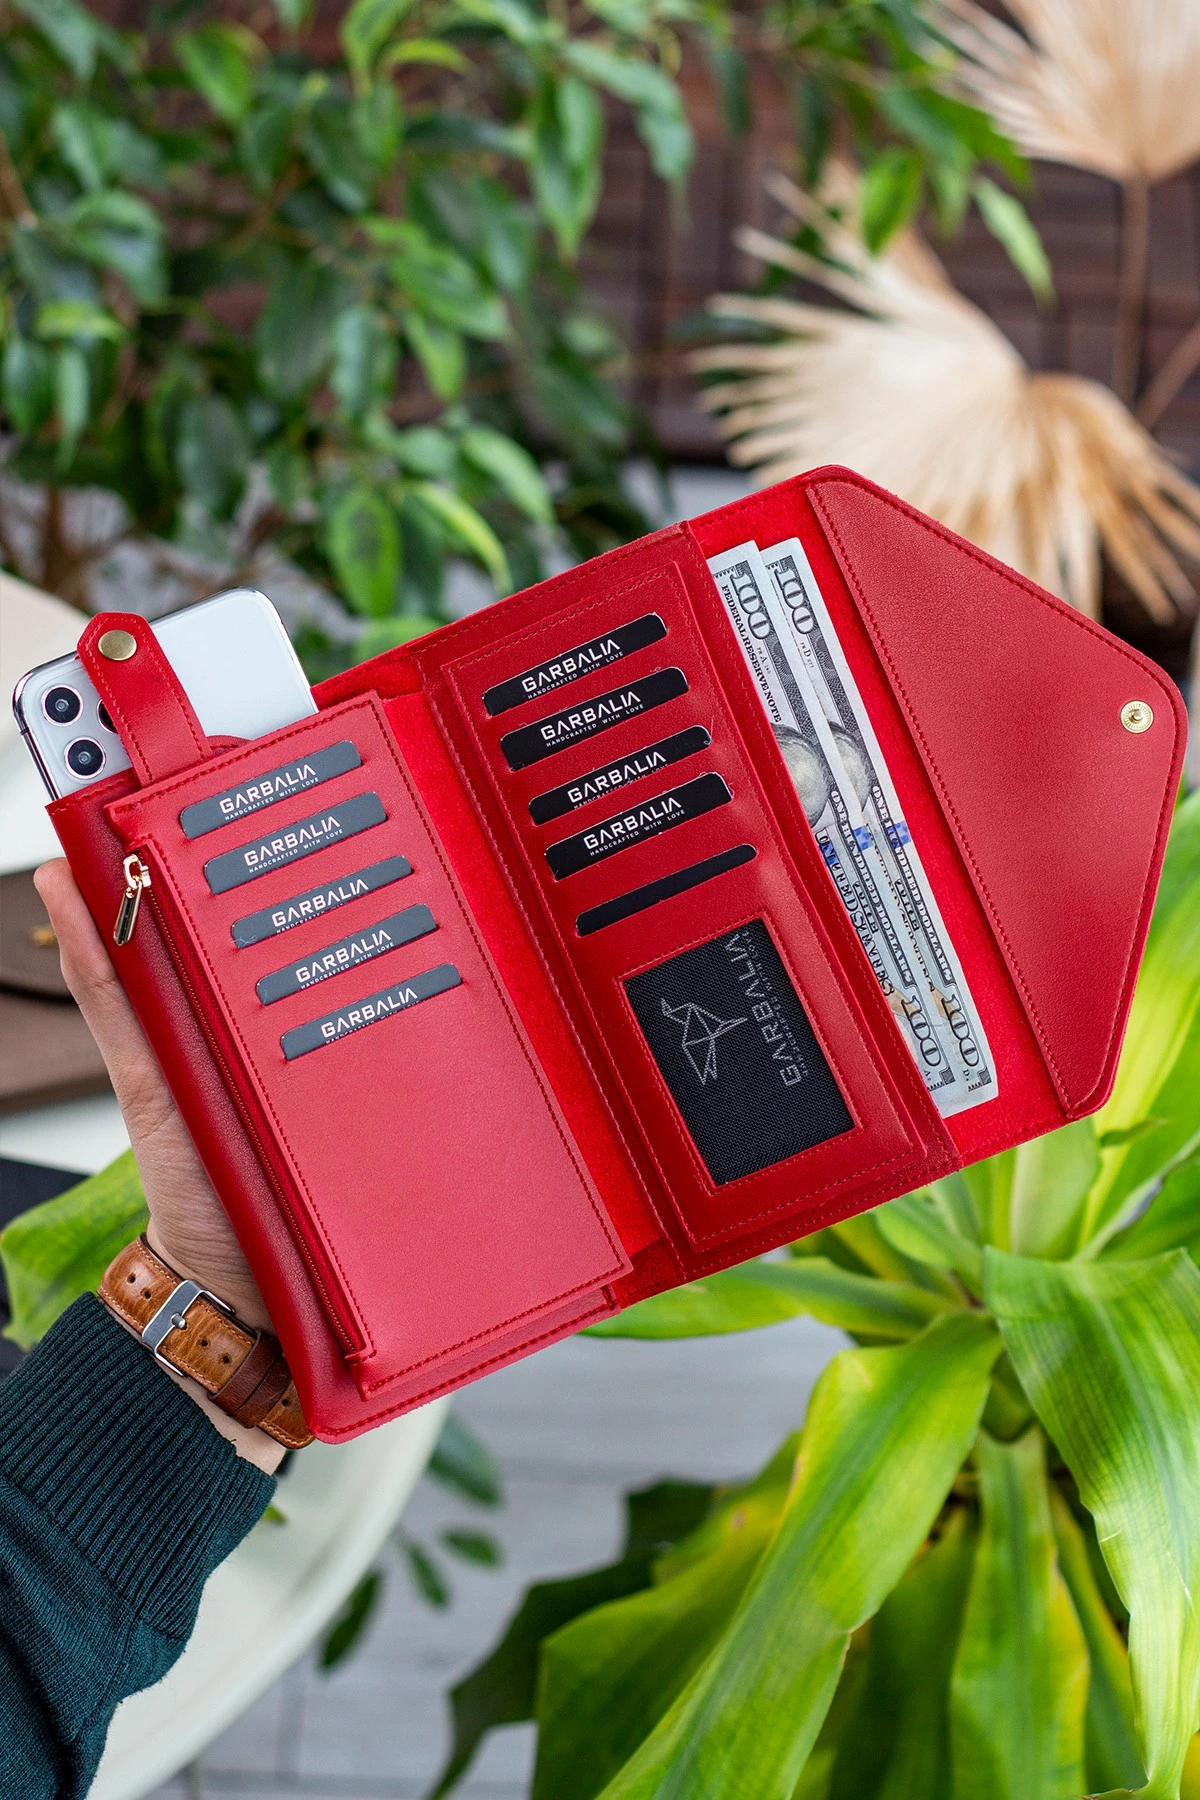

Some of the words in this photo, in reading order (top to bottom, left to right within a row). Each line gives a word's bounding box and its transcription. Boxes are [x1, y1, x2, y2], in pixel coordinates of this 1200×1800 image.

[729, 570, 771, 640] 100
[774, 566, 814, 635] 100
[521, 638, 620, 693] GARBALIA
[527, 672, 577, 699] HANDCRAFTED
[582, 662, 600, 673] WITH
[605, 651, 623, 662] LOVE
[720, 584, 747, 637] FEDERAL
[741, 636, 770, 693] RESERVE
[763, 690, 782, 723] NOTE
[539, 691, 641, 741] GARBALIA
[546, 723, 597, 747] HANDCRAFTED
[601, 713, 620, 724] WITH
[625, 703, 644, 714] LOVE
[218, 764, 316, 814] GARBALIA
[224, 796, 274, 820] HANDCRAFTED
[278, 786, 296, 797] WITH
[301, 776, 319, 787] LOVE
[566, 750, 666, 803] GARBALIA
[243, 816, 341, 866] GARBALIA
[582, 796, 681, 850] GARBALIA
[589, 830, 639, 856] HANDCRAFTED
[643, 819, 662, 831] WITH
[666, 809, 685, 820] LOVE
[248, 848, 298, 873] HANDCRAFTED
[302, 838, 320, 849] WITH
[325, 828, 343, 839] LOVE
[270, 878, 369, 927] GARBALIA
[829, 789, 848, 822] ONE
[874, 904, 913, 983] DOLLARS
[870, 784, 889, 819] ONE
[915, 901, 953, 981] DOLLARS
[294, 929, 391, 983] GARBALIA
[300, 963, 349, 989] HANDCRAFTED
[354, 952, 372, 963] WITH
[376, 941, 394, 953] LOVE
[849, 910, 895, 996] STATES
[320, 987, 418, 1038] GARBALIA
[721, 934, 803, 1087] GARBALIA
[901, 995, 941, 1067] 100
[941, 993, 980, 1068] 100
